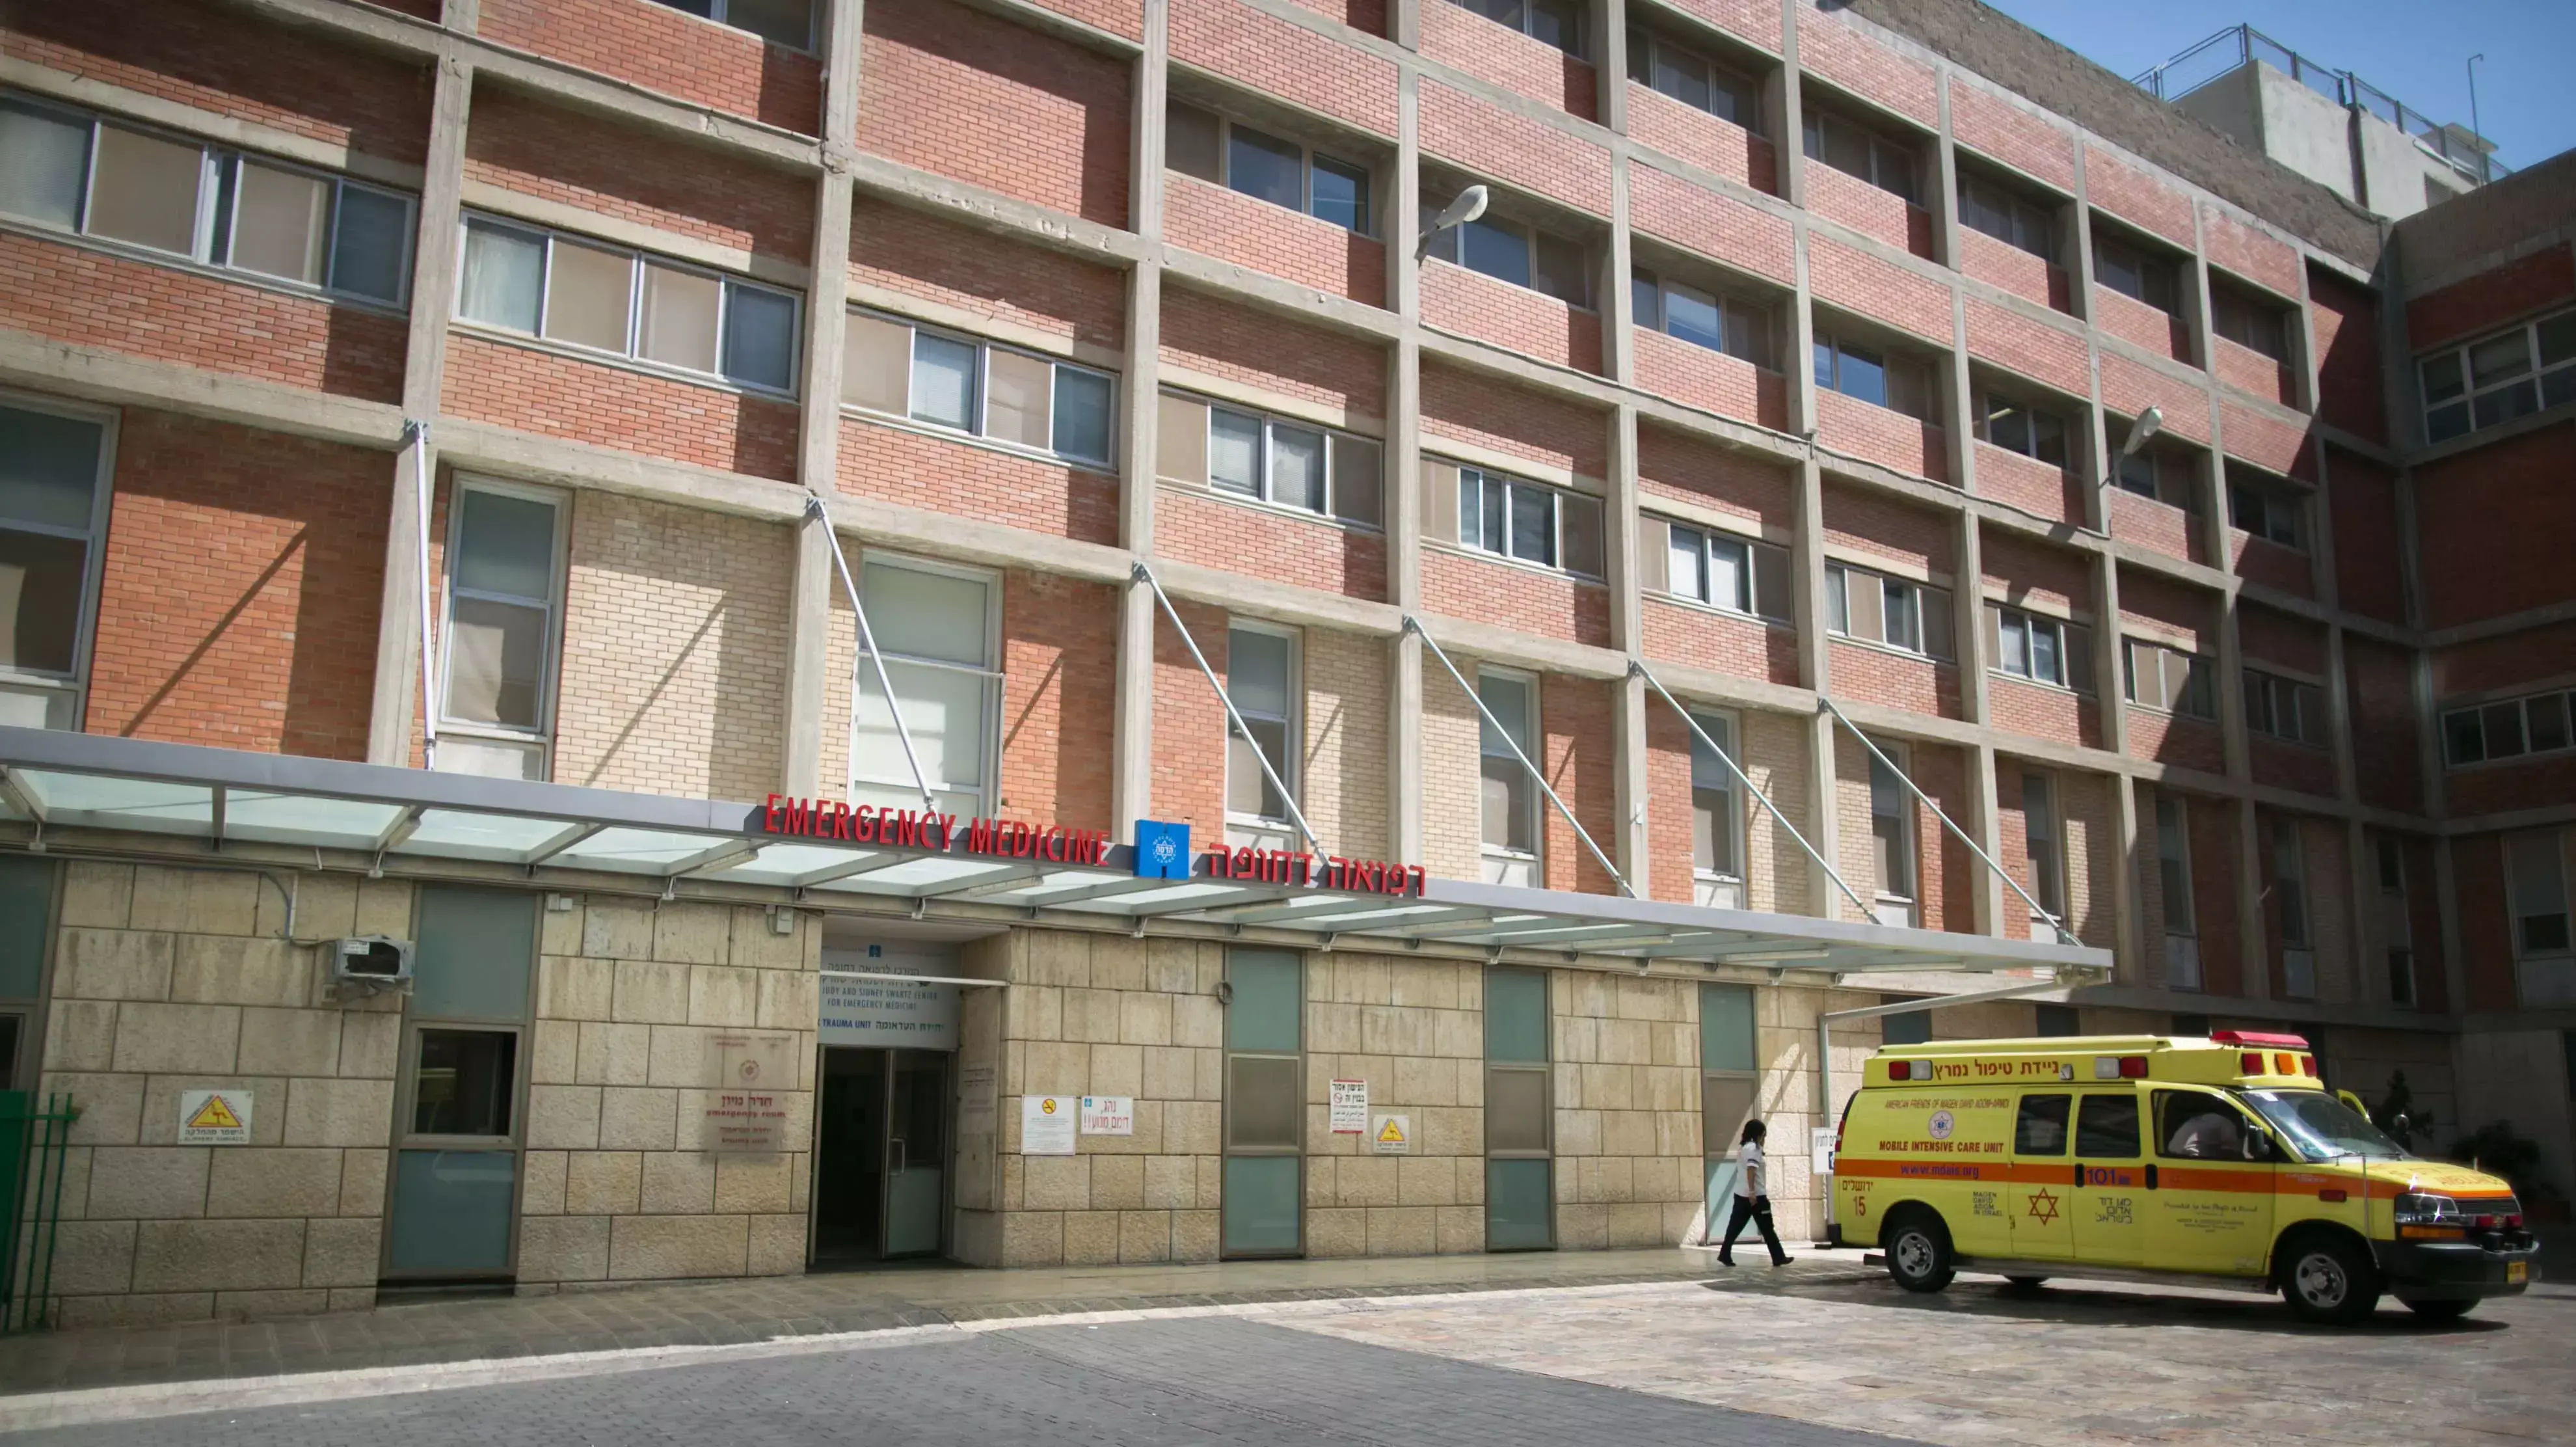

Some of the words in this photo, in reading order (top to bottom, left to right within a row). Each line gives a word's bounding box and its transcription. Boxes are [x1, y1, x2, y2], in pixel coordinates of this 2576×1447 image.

[765, 793, 956, 851] EMERGENCY
[969, 817, 1111, 866] MEDICINE
[1210, 842, 1313, 885] דחופה
[1328, 856, 1426, 897] רפואה
[859, 988, 883, 997] SIDNEY
[886, 989, 911, 999] SWARTZ
[827, 998, 840, 1007] FOR
[844, 999, 883, 1008] EMERGENCY
[885, 1001, 917, 1010] MEDICINE
[822, 1018, 853, 1028] TRAUMA
[855, 1020, 871, 1029] UNIT
[876, 1021, 916, 1031] הטראומה
[1935, 1063, 1969, 1080] נמרץ
[1974, 1059, 2013, 1075] טיפול
[2020, 1061, 2059, 1075] ניידת
[749, 1097, 773, 1107] חדר
[706, 1110, 758, 1119] emergency
[1879, 1141, 1909, 1151] MOBILE
[1912, 1141, 1953, 1152] INTENSIVE
[1957, 1142, 1980, 1153] CARE
[1984, 1143, 2004, 1153] UNIT
[2087, 1168, 2115, 1185] 101
[1842, 1179, 1873, 1192] ירושלים
[1853, 1196, 1866, 1216] 15
[2097, 1197, 2113, 1206] דוד
